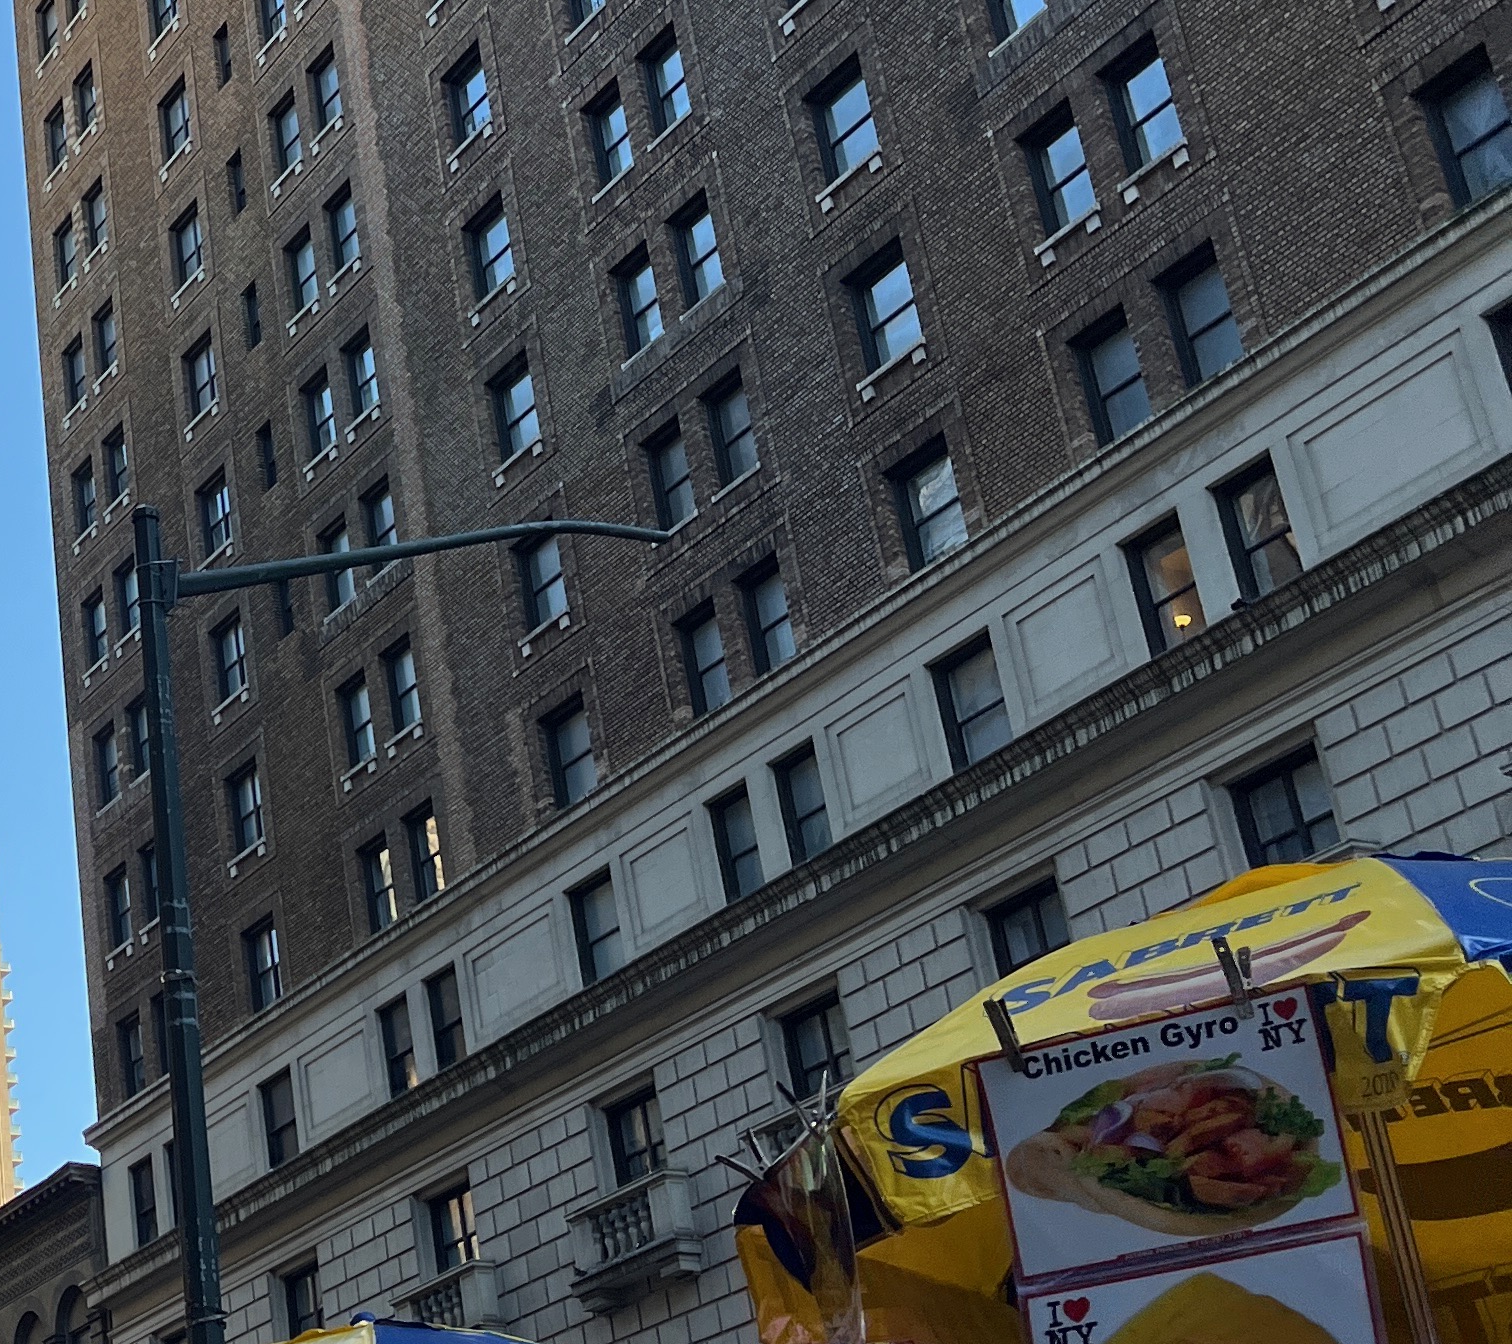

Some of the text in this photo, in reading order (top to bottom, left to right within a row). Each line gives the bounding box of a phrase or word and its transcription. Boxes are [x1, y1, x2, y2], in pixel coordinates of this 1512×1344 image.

[1001, 882, 1362, 1015] SABRETT
[1259, 1002, 1274, 1025] I
[1020, 1017, 1240, 1080] Chicken Gyro
[1259, 1019, 1308, 1052] NY
[1047, 1299, 1062, 1328] I
